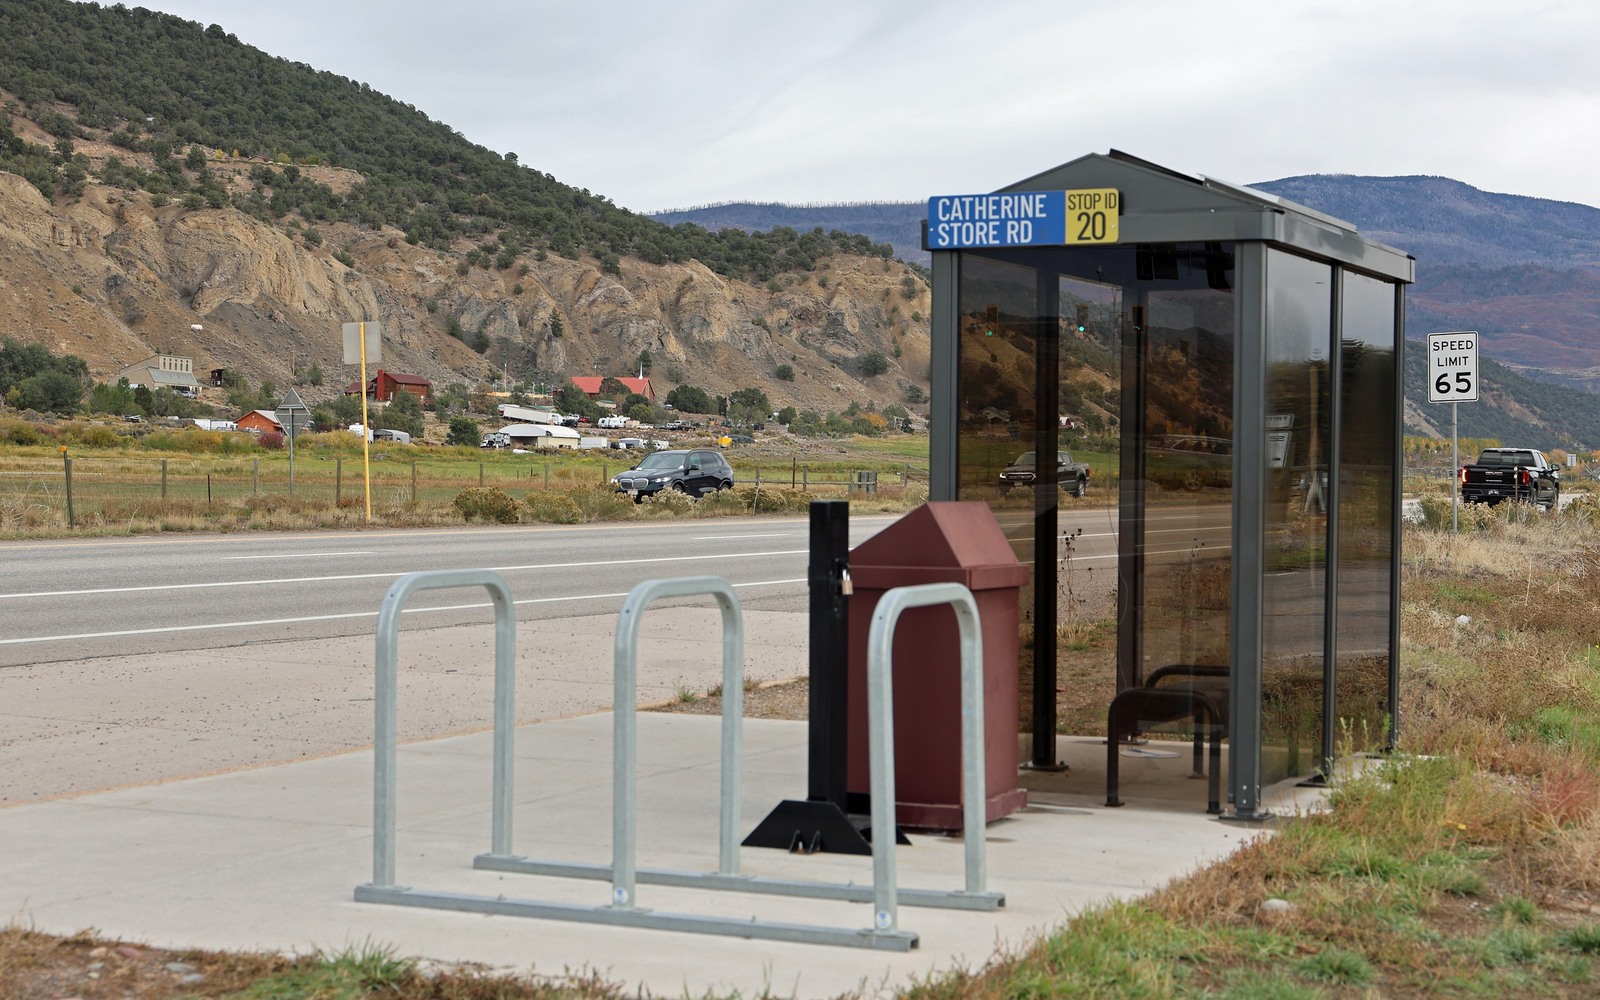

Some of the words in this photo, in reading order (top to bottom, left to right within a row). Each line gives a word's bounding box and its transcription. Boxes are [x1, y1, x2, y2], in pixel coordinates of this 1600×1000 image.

[938, 195, 1047, 221] CATHERINE
[1068, 194, 1101, 210] STOP
[1105, 192, 1117, 209] ID
[938, 221, 1000, 246] STORE
[1006, 220, 1033, 244] RD
[1077, 211, 1106, 241] 20
[1432, 340, 1474, 351] SPEED
[1437, 356, 1469, 367] LIMIT
[1435, 371, 1471, 394] 65
